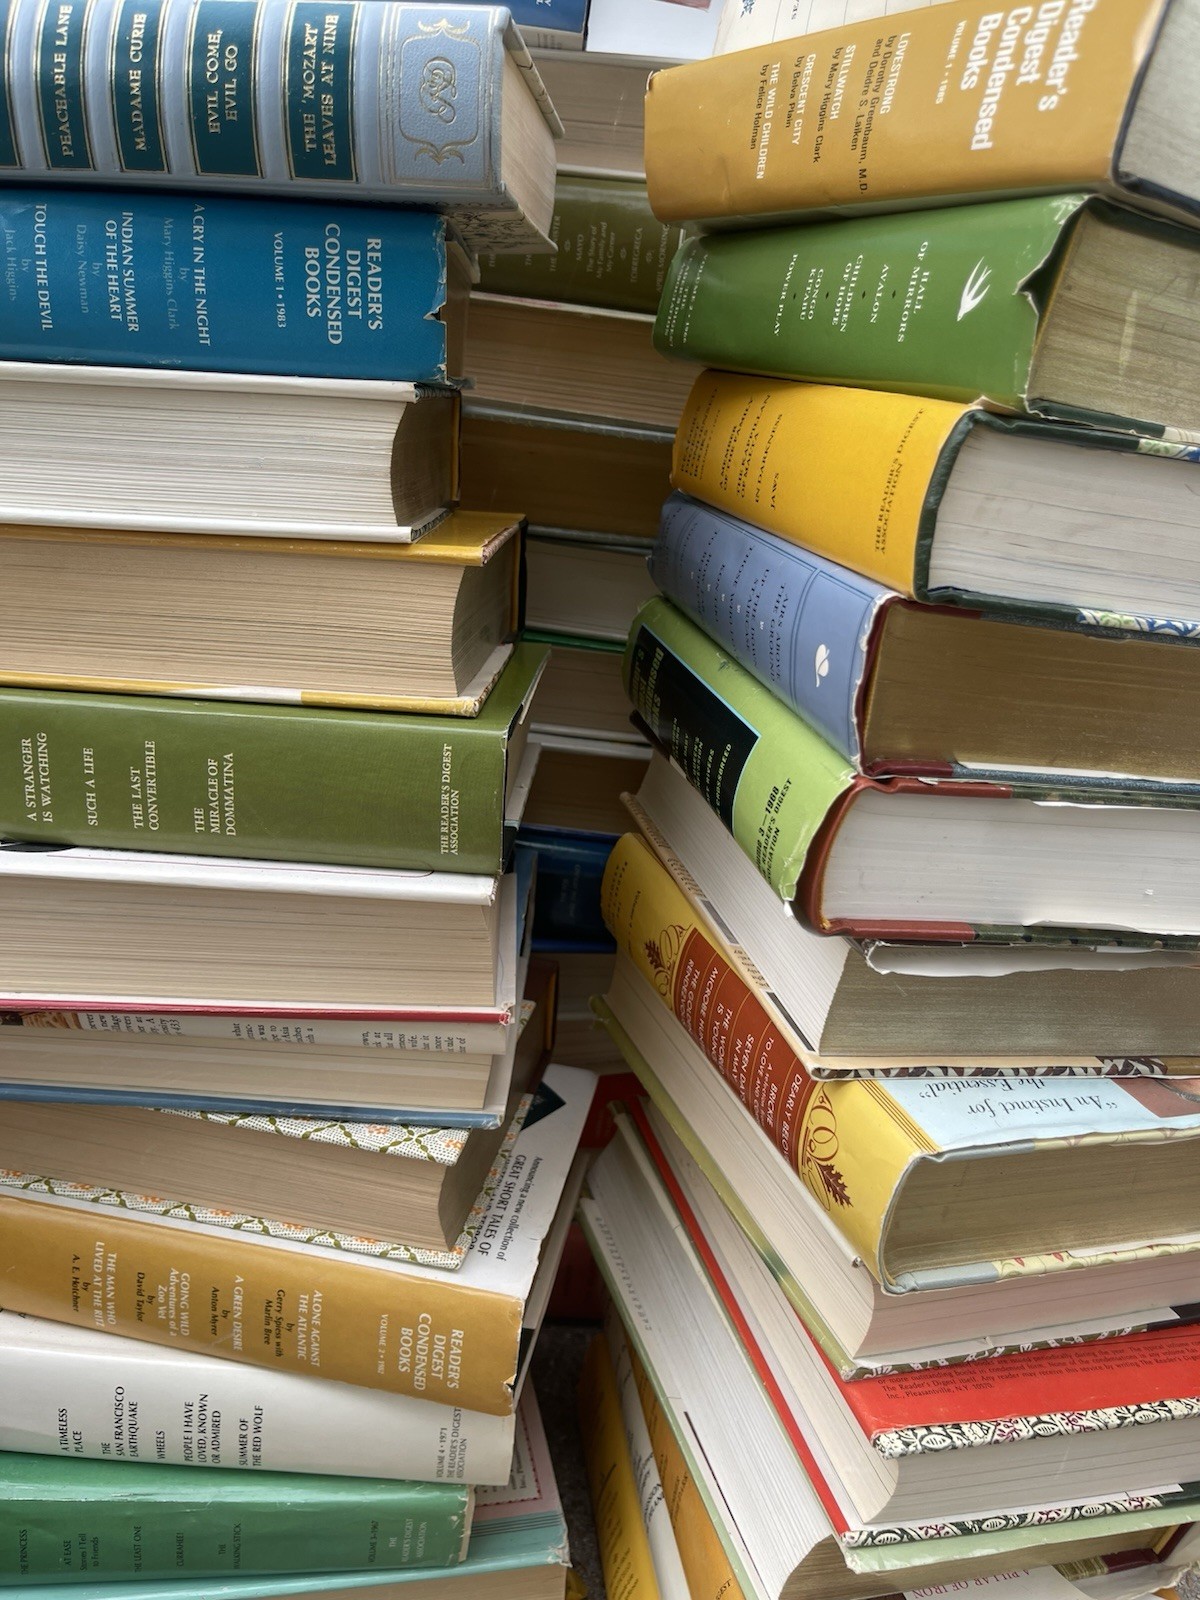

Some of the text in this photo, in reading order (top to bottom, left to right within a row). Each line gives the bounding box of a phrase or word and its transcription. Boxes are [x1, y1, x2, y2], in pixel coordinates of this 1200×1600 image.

[880, 32, 911, 114] LOVESTRONG
[960, 12, 1004, 90] Books
[1016, 0, 1065, 86] Digest
[1038, 0, 1097, 111] Reader's
[54, 5, 74, 156] PEACEABLE LANE
[129, 13, 147, 151] MADAME CURIE
[206, 29, 223, 134] EVIL COME,
[225, 45, 238, 121] EVIL GO
[302, 23, 318, 152] THE 'MOZART'
[321, 14, 340, 165] LEAVES AT NINE
[792, 54, 816, 145] CRESCENT CITY
[813, 47, 844, 163] by Mary Higgins Clark
[830, 45, 856, 120] STILLWATCH
[851, 38, 883, 151] and Deidre S. Laiken
[971, 6, 1033, 150] Condensed
[756, 62, 781, 179] THE WILD CHILDREN
[858, 35, 897, 194] by Dorothy Greenbaum, M.D.
[34, 204, 53, 331] TOUCH THE DEVIL
[76, 224, 89, 313] Daisy Newman
[105, 220, 122, 321] OF THE HEART
[121, 211, 139, 332] INDIAN SUMMER
[162, 217, 180, 330] Mary Higgins Clark
[193, 204, 211, 346] A CRY IN THE NIGHT
[304, 247, 322, 318] BOOKS
[325, 223, 343, 345] CONDENSED
[346, 250, 362, 319] DIGEST
[367, 238, 383, 330] READER'S
[774, 254, 798, 336] POWER PLAY
[832, 263, 852, 325] OF HOPE
[840, 254, 863, 332] CHILDREN
[871, 264, 889, 323] AVALON
[898, 241, 928, 342] OF MIRRORS
[914, 272, 929, 313] HALL
[756, 414, 782, 503] IN DARKNESS
[897, 408, 924, 453] DIGEST
[771, 473, 779, 509] JAWS
[881, 464, 902, 554] ASSOCIATION
[22, 738, 37, 821] A STRANGER
[37, 733, 53, 822] IS WATCHING
[83, 748, 98, 826] SUCH A LIFE
[130, 767, 144, 828] THE LAST
[145, 741, 159, 830] CONVERTIBLE
[208, 759, 220, 834] MIRACLE OF
[223, 753, 236, 836] DOMMATINA
[442, 744, 452, 782] DIGEST
[716, 743, 731, 807] CROSSBREED
[194, 808, 204, 833] THE
[441, 785, 450, 833] READER'S
[450, 790, 459, 855] ASSOCIATION
[763, 778, 792, 866] READER'S DIGEST
[700, 967, 718, 1017] MICROBE
[717, 1003, 724, 1014] IS
[723, 1009, 733, 1030] THE
[735, 1039, 742, 1053] IN
[742, 1034, 754, 1072] SEVEN
[767, 1083, 778, 1127] BRICKIE
[784, 1074, 802, 1120] DEARLY
[967, 1098, 996, 1118] for
[1000, 1098, 1073, 1114] Instinct
[1018, 1078, 1046, 1089] the
[477, 1155, 526, 1256] GREAT SHORT TALES OF
[515, 1199, 525, 1212] new
[520, 1157, 543, 1193] Announcing
[496, 1252, 506, 1261] of
[500, 1215, 519, 1250] collection
[106, 1253, 117, 1325] THE MAN WHO
[136, 1273, 145, 1322] David Taylor
[179, 1273, 191, 1336] GOING WILD
[232, 1274, 244, 1351] A GREEN DESIRE
[297, 1293, 309, 1360] THE ATLANTIC
[310, 1290, 322, 1367] ALONE AGAINST
[398, 1327, 413, 1372] BOOKS
[414, 1313, 432, 1391] CONDENSED
[431, 1334, 446, 1379] DIGEST
[447, 1329, 464, 1389] READER'S
[183, 1402, 194, 1427] HAVE
[900, 1381, 931, 1390] Reader's
[932, 1378, 956, 1387] Digest
[101, 1443, 111, 1454] THE
[114, 1386, 125, 1456] SAN FRANCISCO
[129, 1401, 138, 1457] EARTHQUAKE
[156, 1430, 165, 1459] WHEELS
[183, 1435, 193, 1461] PEOPLE
[197, 1394, 208, 1463] LOVED, KNOWN
[211, 1410, 221, 1464] OR ADMIRED
[239, 1418, 249, 1465] SUMMER OF
[252, 1405, 264, 1466] THE RED WOLF
[452, 1408, 461, 1438] DIGEST
[912, 1585, 948, 1598] IRON
[952, 1581, 968, 1591] OF
